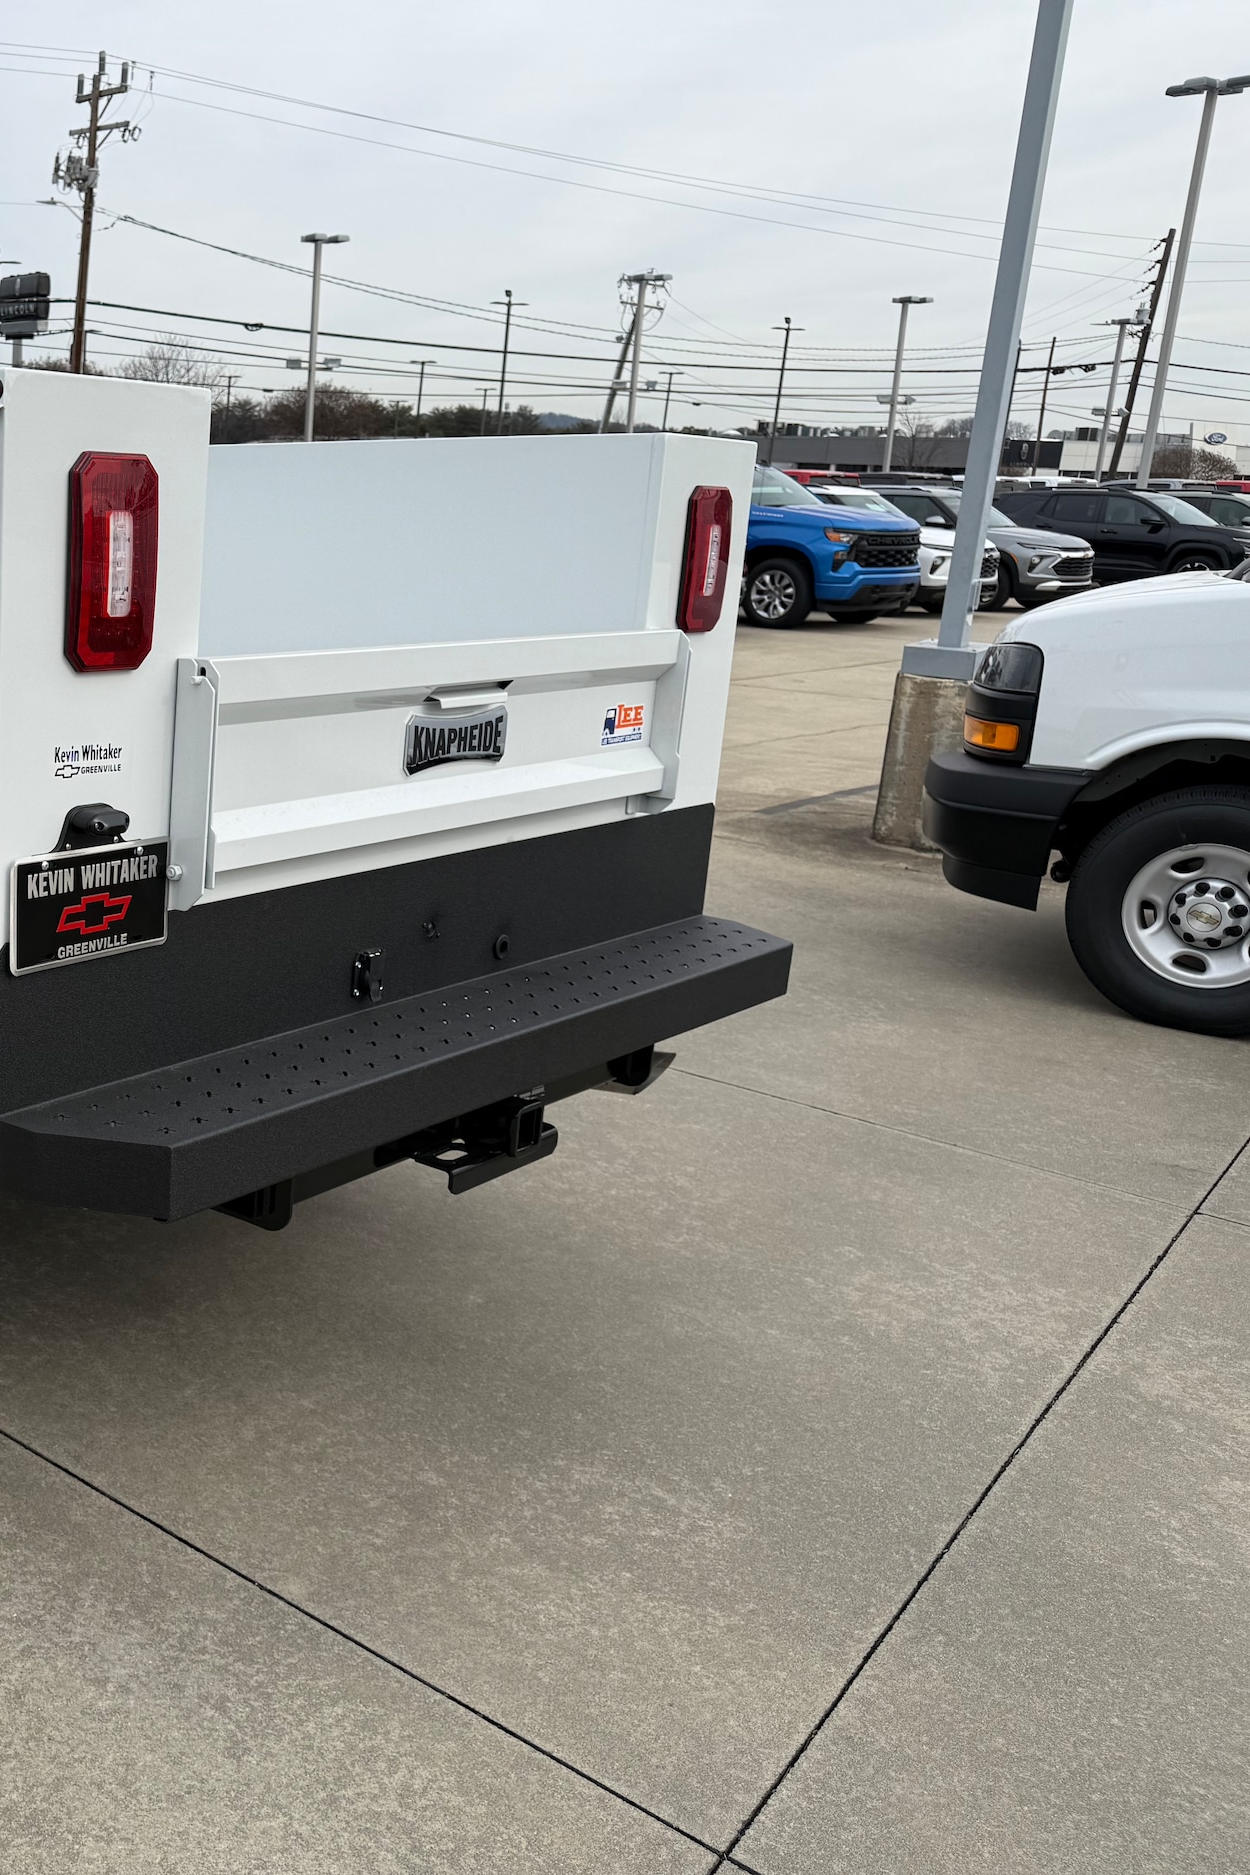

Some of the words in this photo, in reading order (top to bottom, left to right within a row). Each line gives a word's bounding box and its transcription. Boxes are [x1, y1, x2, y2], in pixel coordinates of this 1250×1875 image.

[0, 303, 36, 317] LINCOLN
[615, 704, 644, 729] LEE
[411, 715, 504, 765] KNAPHEIDE
[54, 745, 80, 764] Kevin
[81, 743, 123, 762] Whitaker
[80, 763, 122, 775] GREENVILLE
[27, 867, 75, 900] KEVIN
[80, 854, 158, 891] WHITAKER
[57, 932, 128, 959] GREENVILLE
